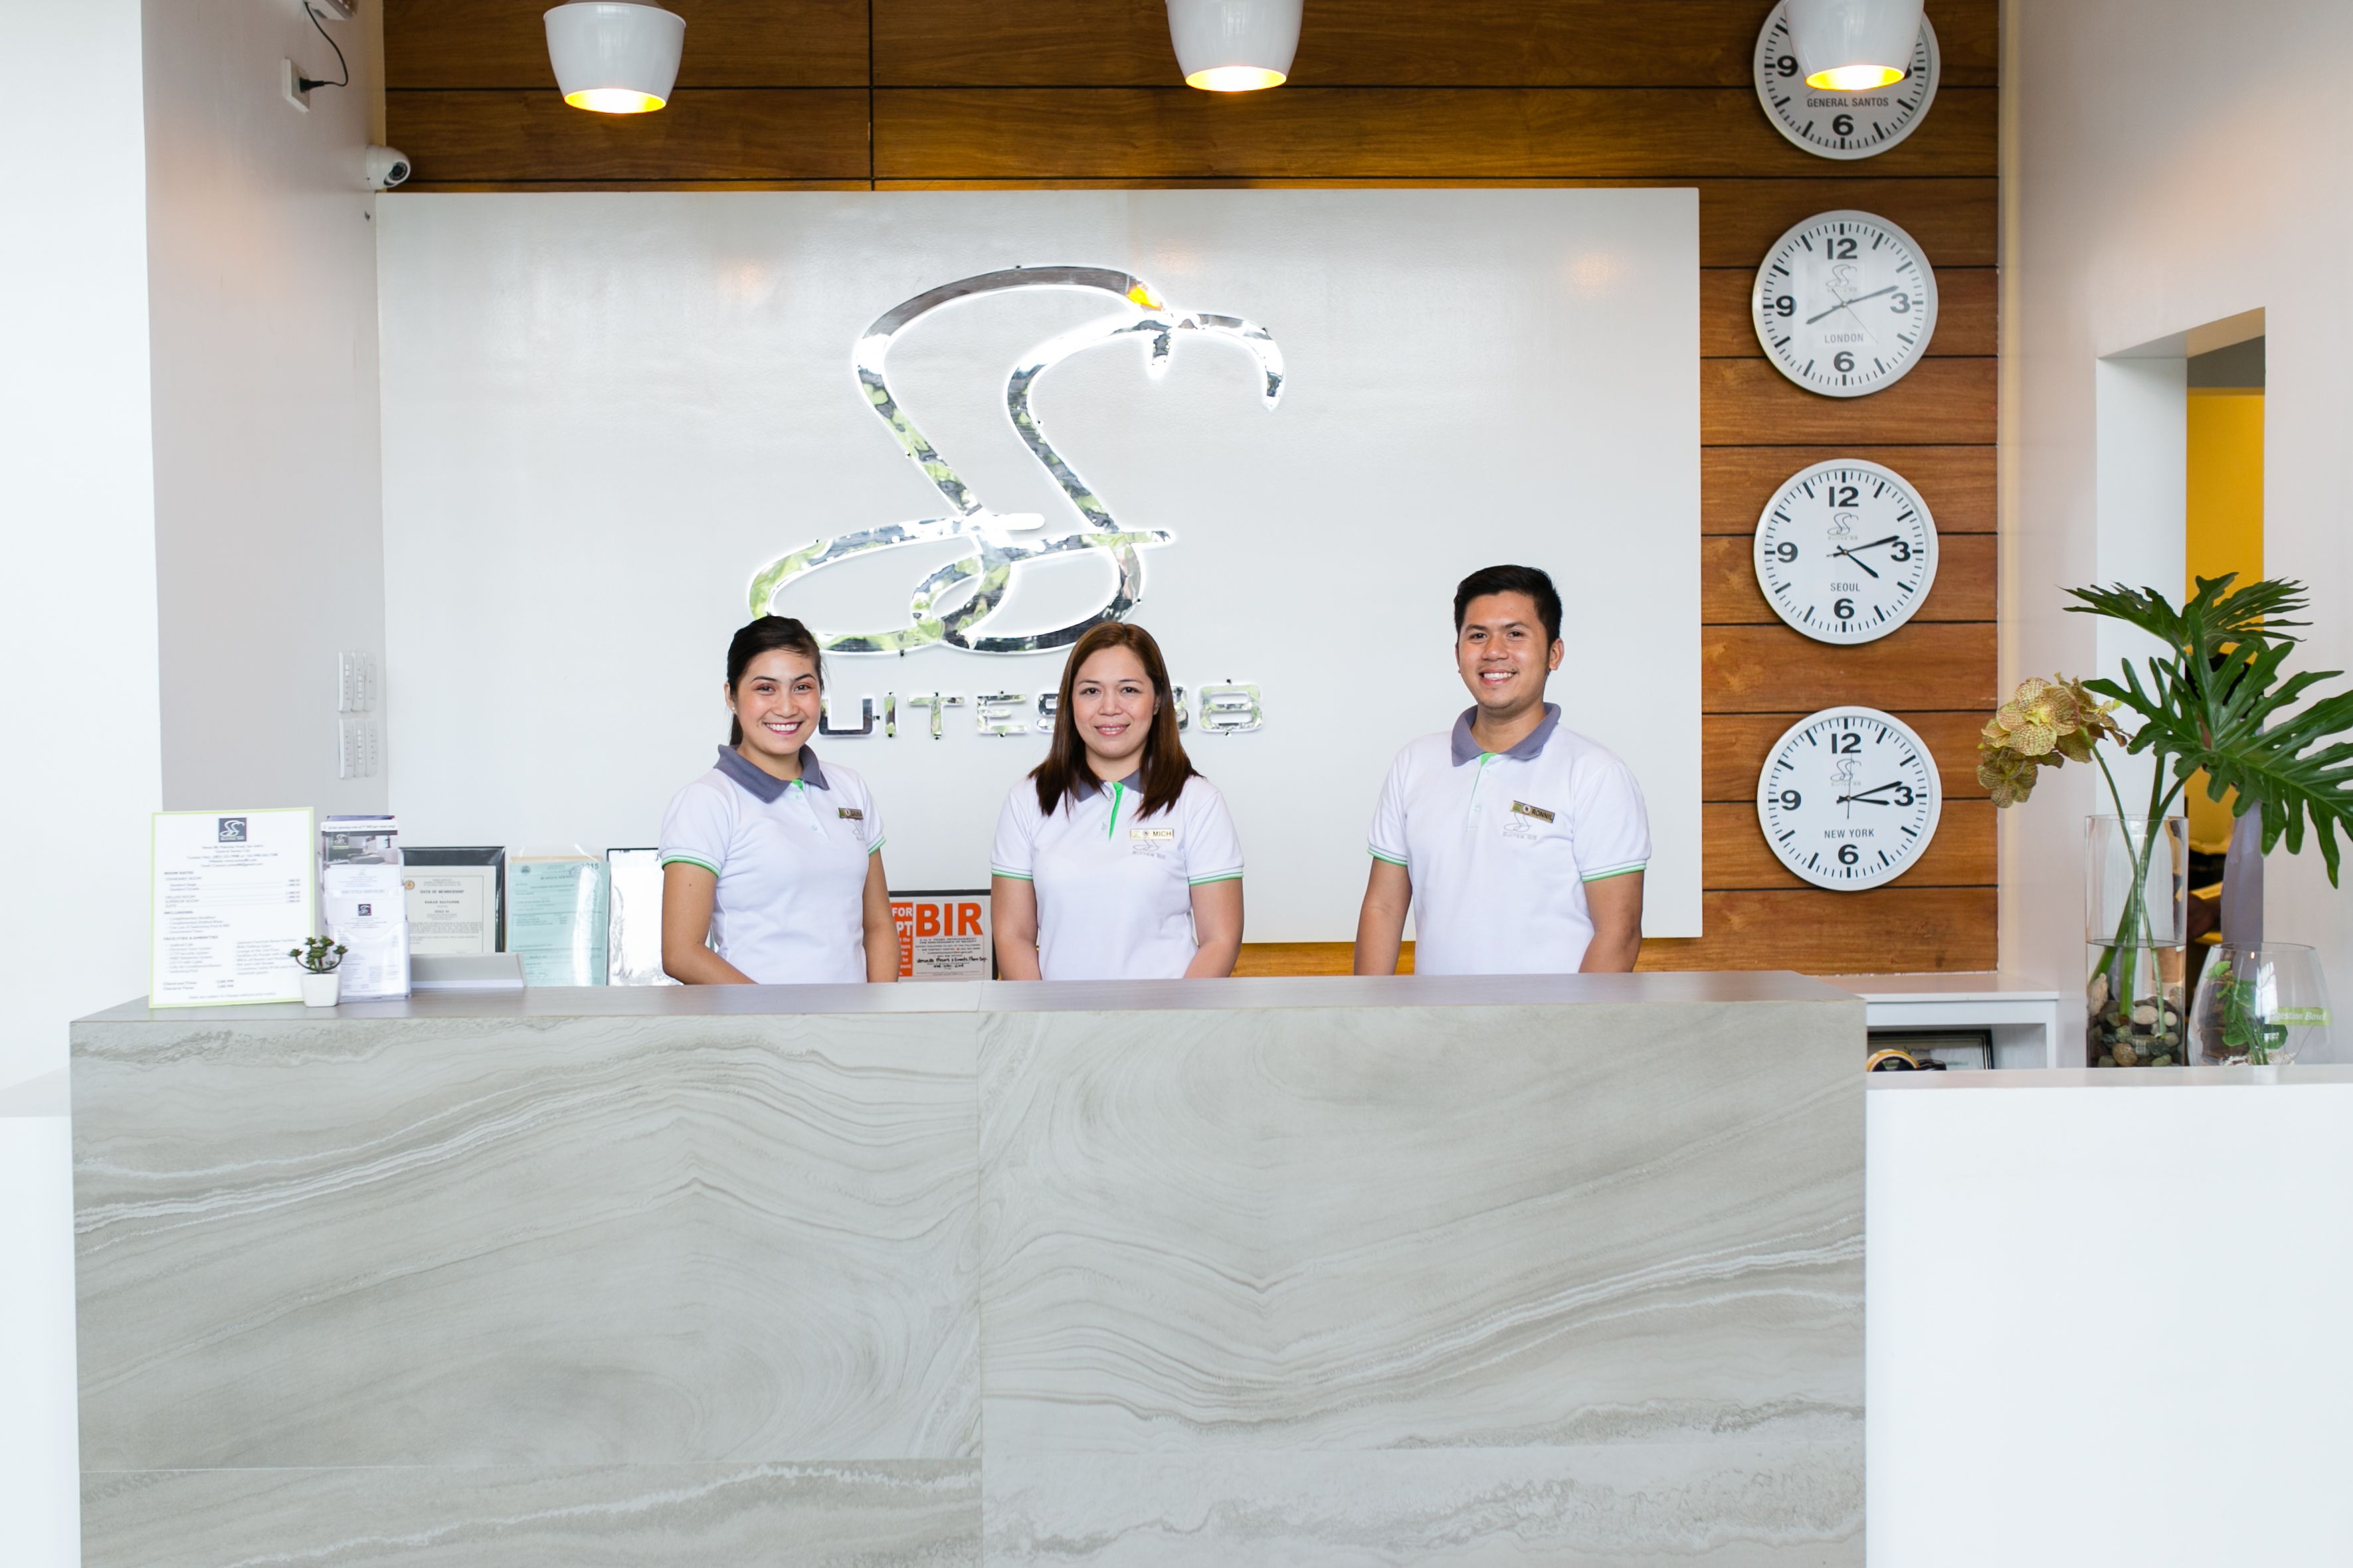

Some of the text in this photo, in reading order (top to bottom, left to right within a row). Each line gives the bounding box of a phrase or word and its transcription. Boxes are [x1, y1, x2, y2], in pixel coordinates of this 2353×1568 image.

[1776, 55, 1798, 78] 9
[1807, 97, 1889, 108] GENERAL SANTOS
[1832, 114, 1854, 135] 6
[1828, 238, 1857, 260] 12
[1776, 296, 1797, 317] 9
[1890, 293, 1911, 313] 3
[1824, 333, 1864, 343] LONDON
[1834, 351, 1855, 373] 6
[1828, 485, 1859, 507] 12
[1777, 542, 1798, 563] 9
[1891, 541, 1911, 562] 3
[1830, 582, 1861, 592] SEOUL
[1834, 598, 1855, 620] 6
[1832, 733, 1861, 754] 12
[1781, 790, 1802, 811] 9
[1893, 786, 1915, 806] 3
[1824, 828, 1875, 839] NEW YORK
[1837, 844, 1859, 865] 6
[892, 907, 913, 917] FOR
[916, 903, 983, 937] BIR
